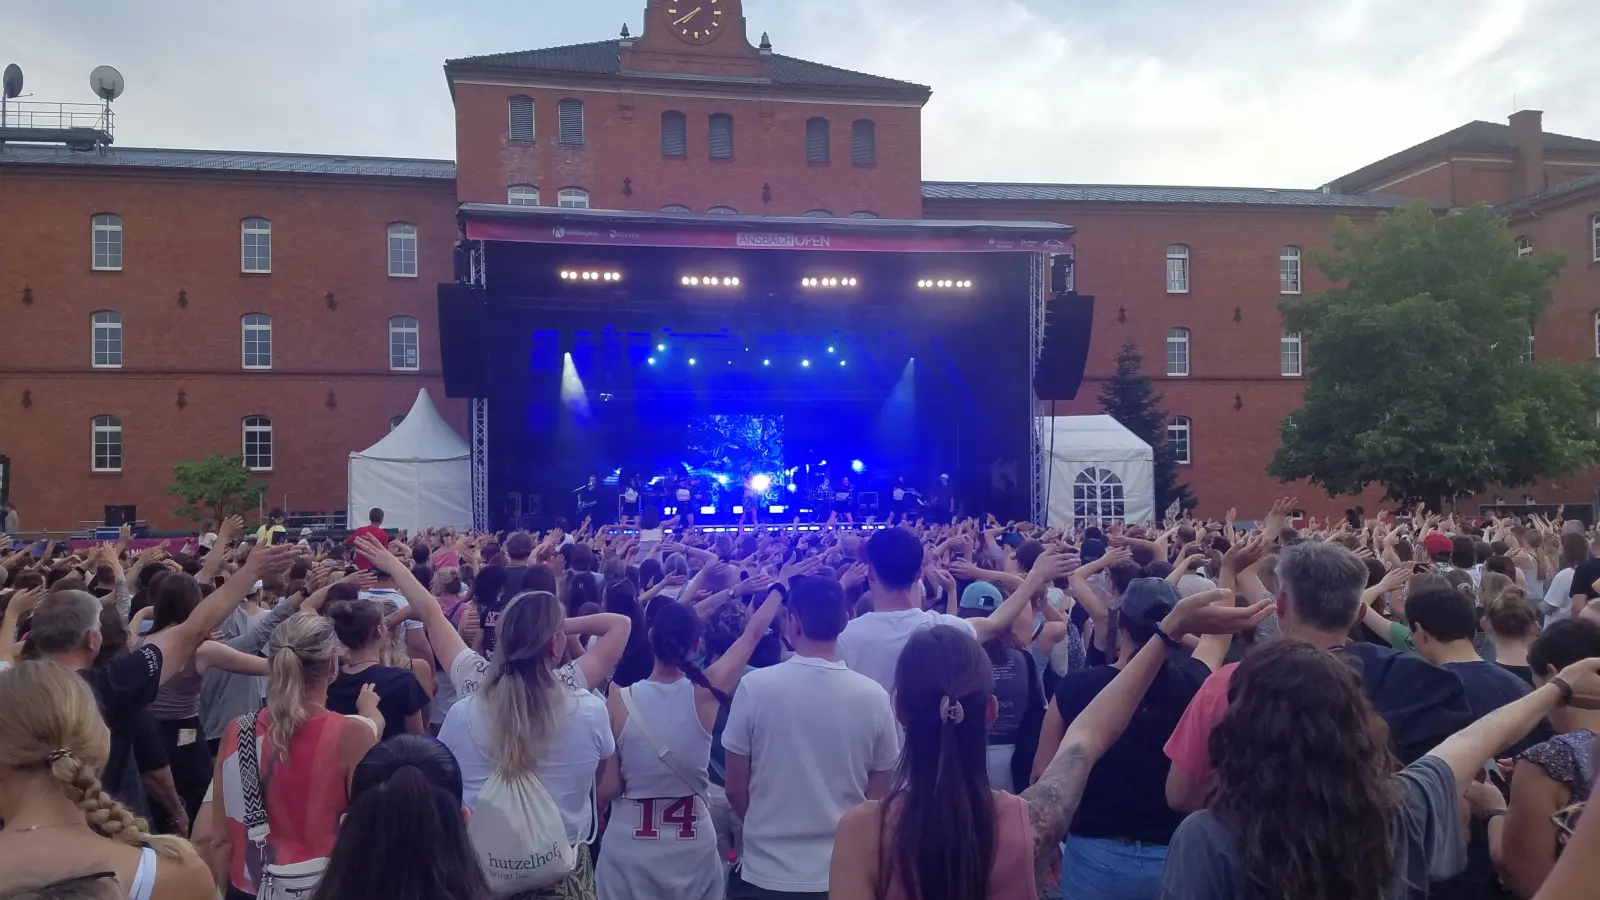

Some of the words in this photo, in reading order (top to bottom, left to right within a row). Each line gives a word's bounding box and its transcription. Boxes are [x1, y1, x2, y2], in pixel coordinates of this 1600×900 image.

[739, 233, 793, 245] ANSBACH
[795, 235, 830, 246] OPEN
[632, 797, 698, 840] 14
[487, 841, 558, 870] hutzelhof
